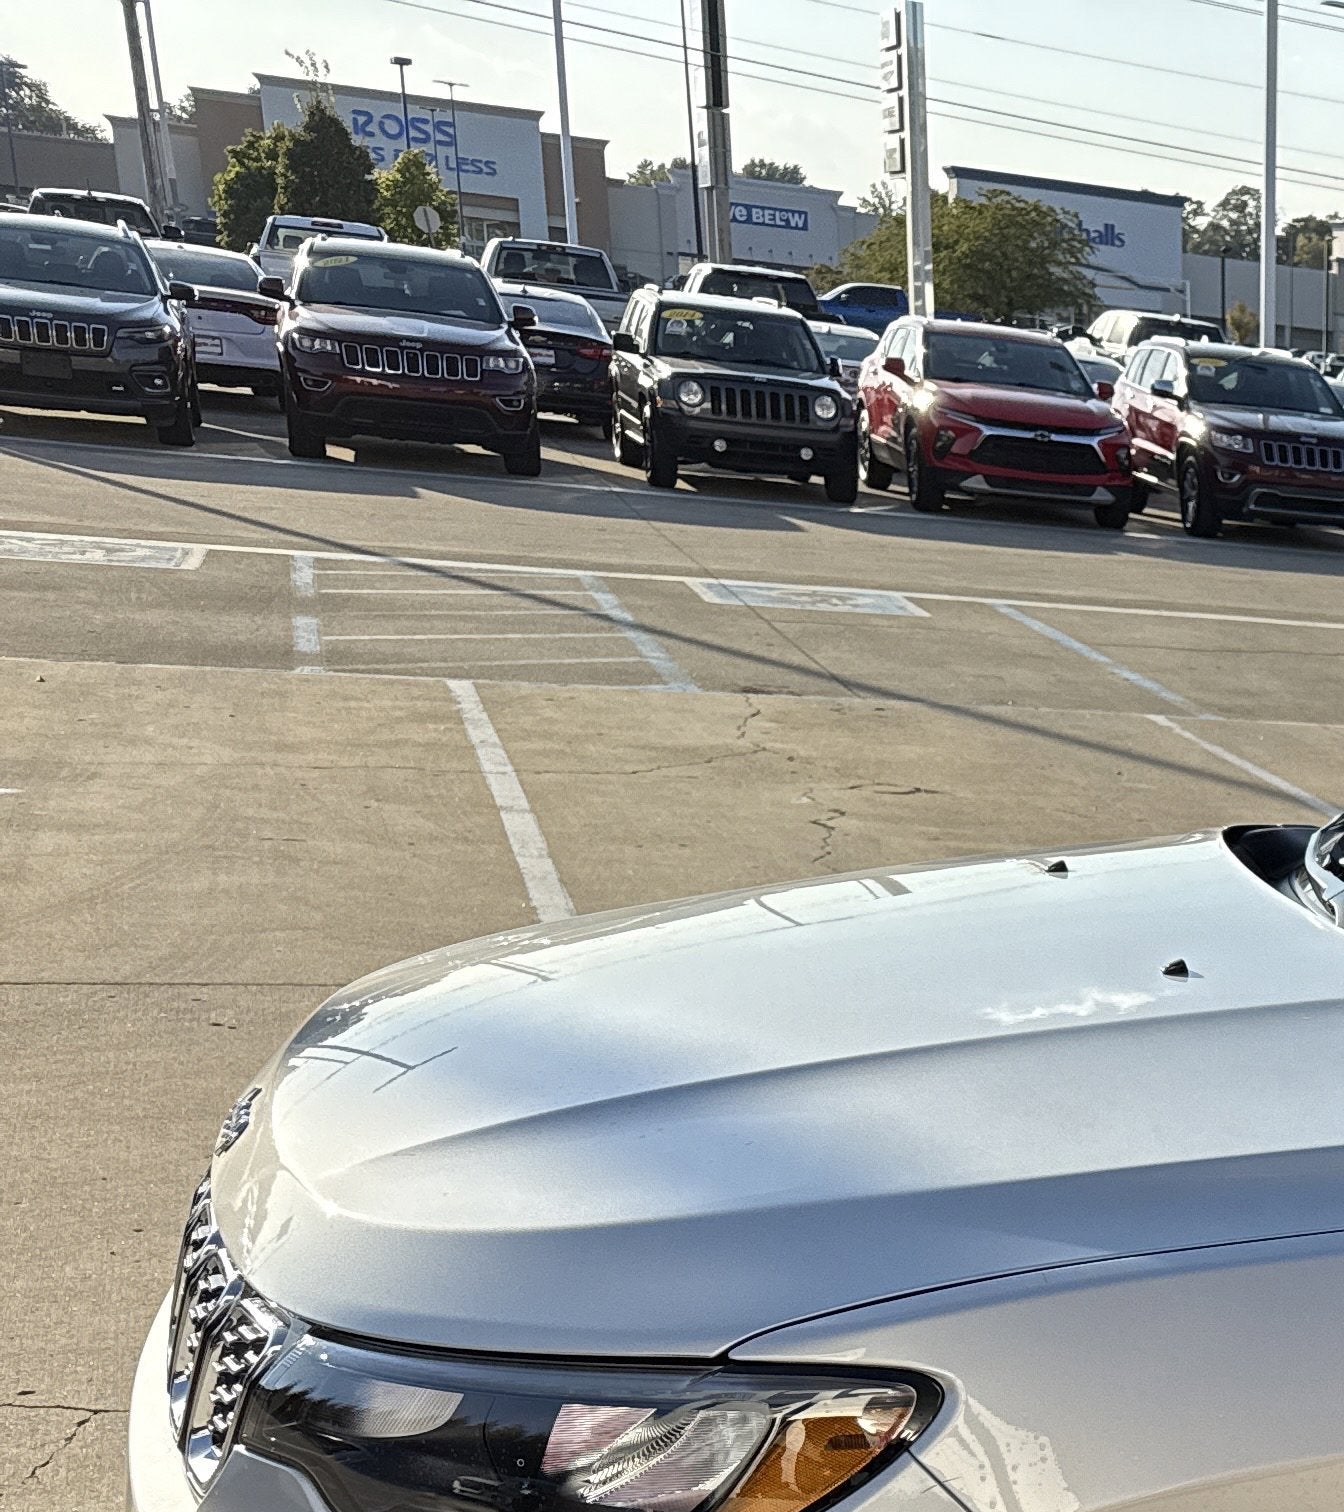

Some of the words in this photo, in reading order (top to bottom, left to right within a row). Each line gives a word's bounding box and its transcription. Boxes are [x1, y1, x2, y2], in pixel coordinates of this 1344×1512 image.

[351, 109, 454, 147] ROSS
[445, 154, 497, 177] LESS
[752, 208, 805, 228] BELOW
[29, 310, 53, 319] Jeep
